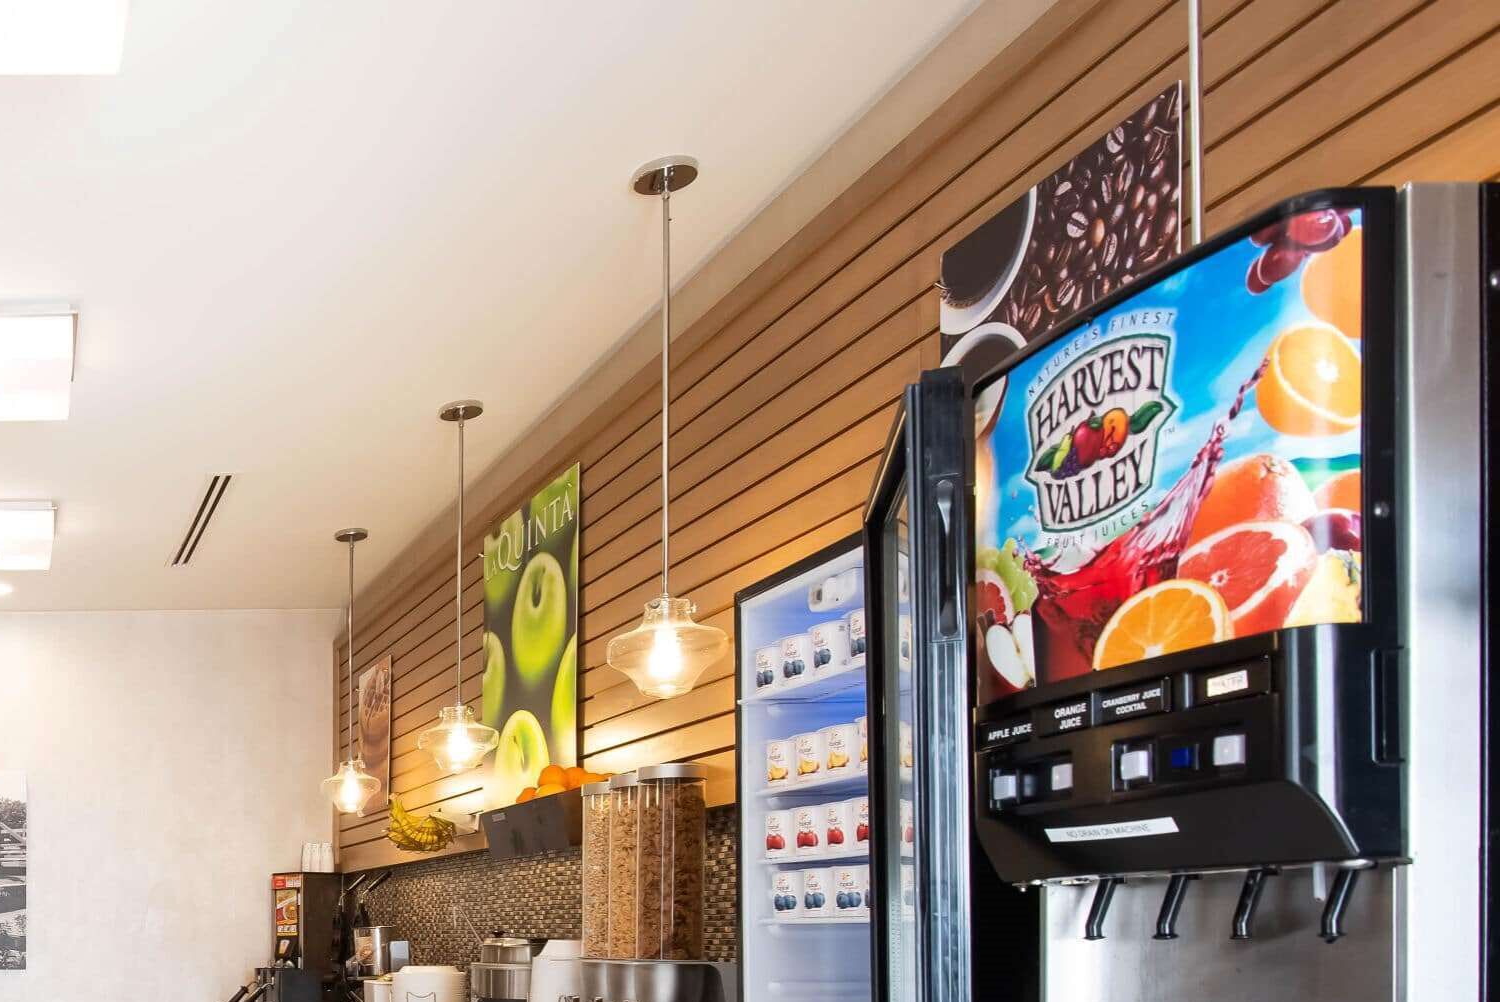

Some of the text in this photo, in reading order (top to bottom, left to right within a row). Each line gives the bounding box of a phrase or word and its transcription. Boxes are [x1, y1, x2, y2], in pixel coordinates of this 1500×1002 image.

[1028, 311, 1175, 396] NATURE'S FINEST
[1036, 345, 1164, 449] HARVEST
[1044, 439, 1148, 524] VALLEY
[498, 489, 573, 571] QUINTA
[1047, 500, 1150, 549] FRUIT JUICES
[1054, 702, 1087, 719] ORANGE
[1102, 687, 1161, 708] CRANBERRY JUICE
[1116, 701, 1148, 715] COCKTAIL
[988, 723, 1032, 741] APPLE JUICE
[1060, 716, 1082, 730] JUICE
